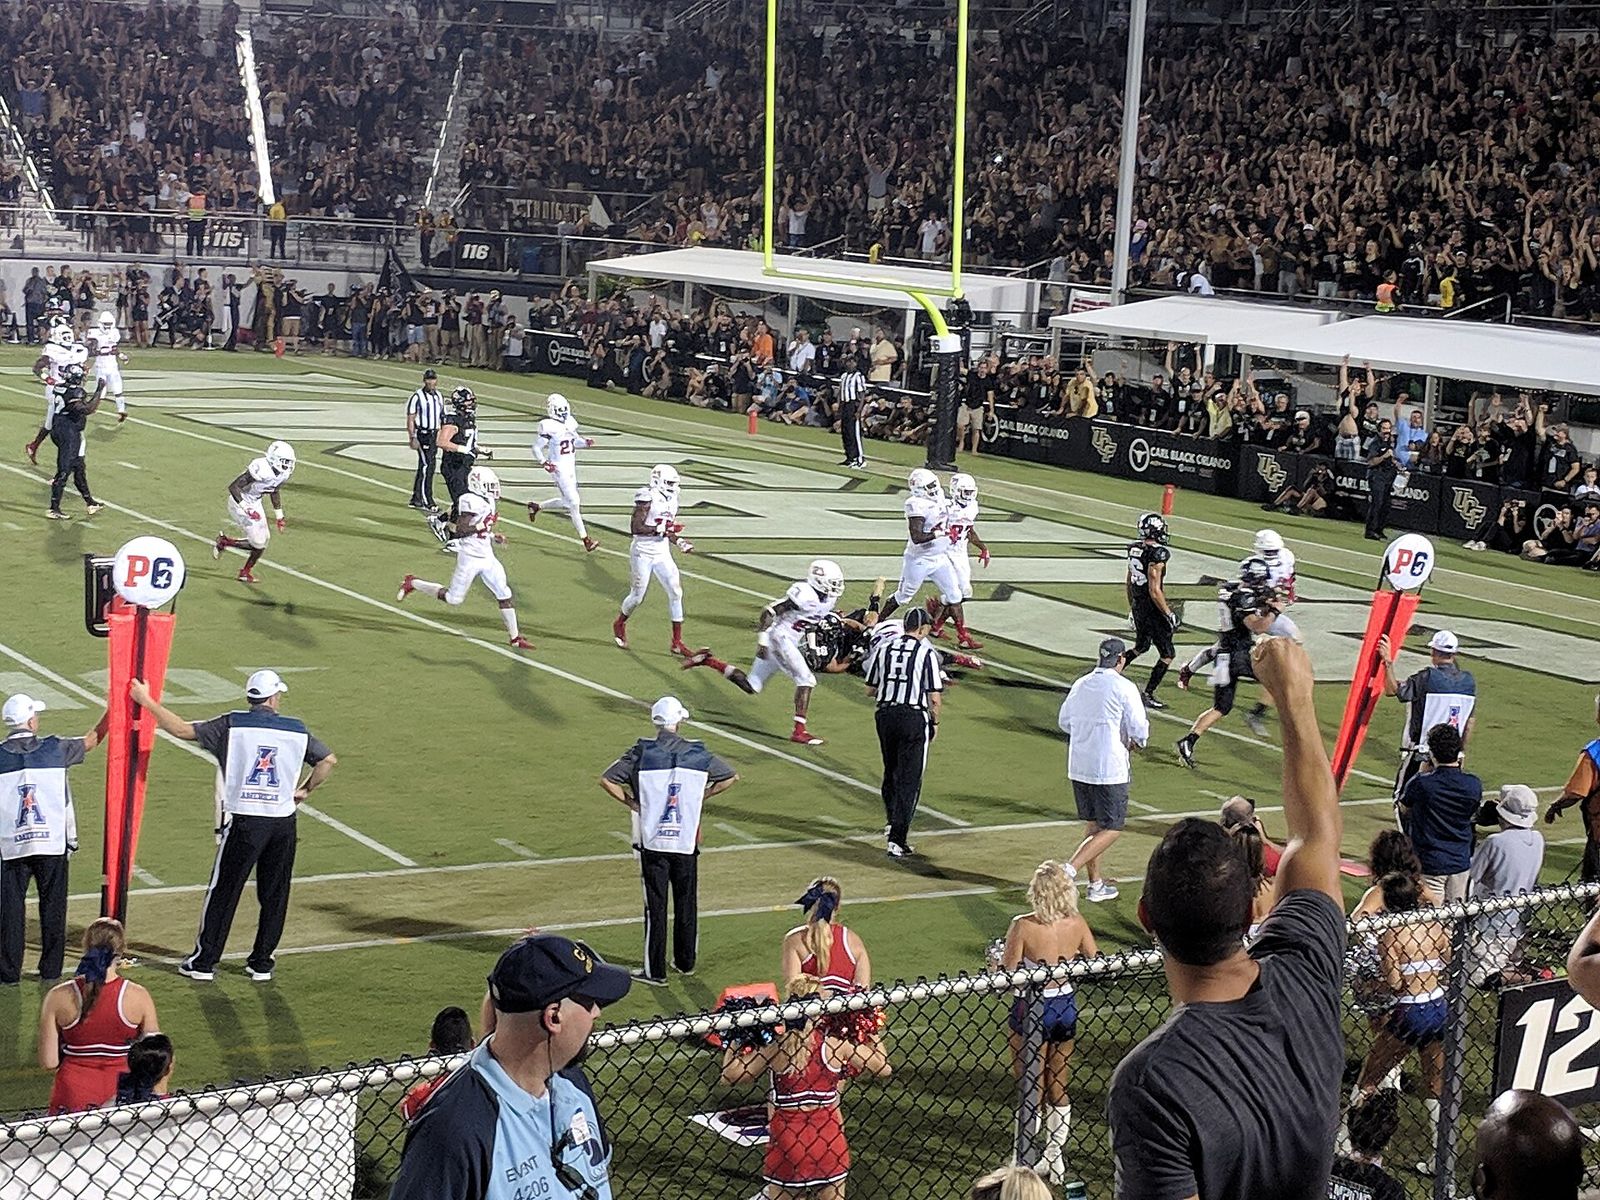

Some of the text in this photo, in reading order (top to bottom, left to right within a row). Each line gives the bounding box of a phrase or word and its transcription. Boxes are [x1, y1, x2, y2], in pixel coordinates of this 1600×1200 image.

[212, 231, 243, 247] 115
[461, 243, 490, 260] 116
[1091, 425, 1118, 463] UCF
[1150, 446, 1170, 459] CARL
[1170, 449, 1196, 463] BLACK
[1196, 454, 1232, 470] ORLANDO
[1256, 452, 1288, 493] UCF
[1335, 475, 1358, 490] CARL
[1451, 486, 1488, 530] UCF
[124, 555, 175, 590] P6
[1392, 548, 1428, 577] P6
[887, 650, 912, 680] H
[246, 745, 280, 788] A
[15, 783, 47, 829] A
[505, 1155, 539, 1182] EVENT
[513, 1176, 550, 1200] 4206
